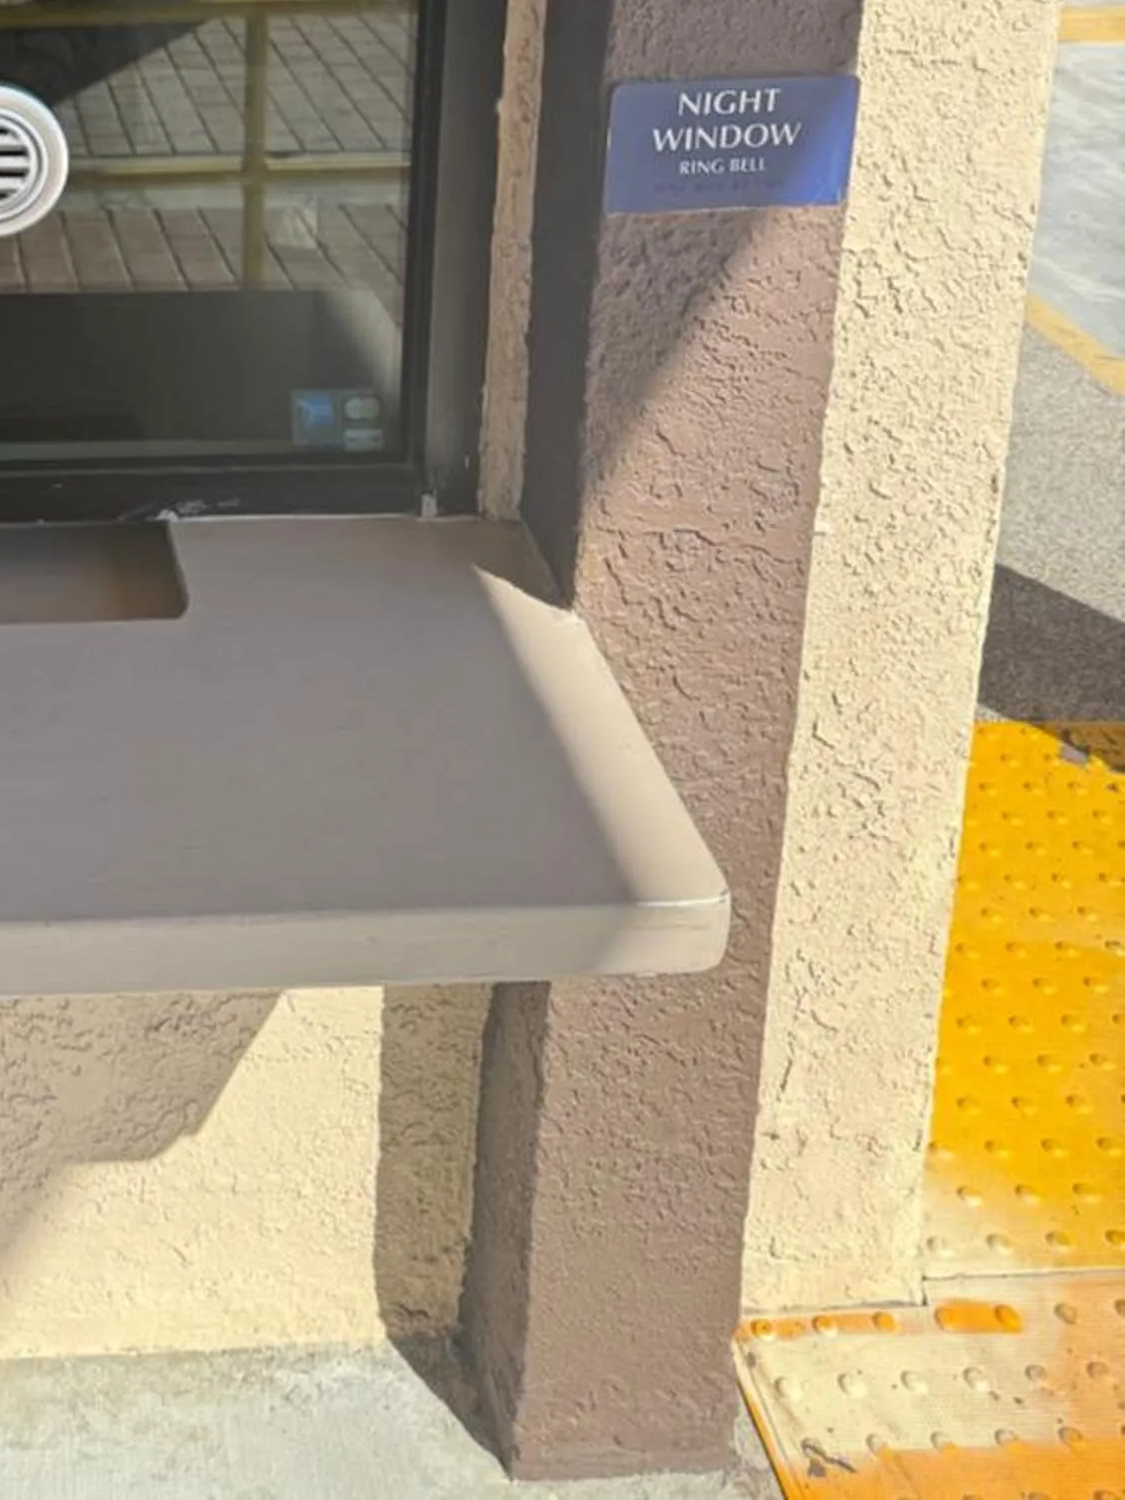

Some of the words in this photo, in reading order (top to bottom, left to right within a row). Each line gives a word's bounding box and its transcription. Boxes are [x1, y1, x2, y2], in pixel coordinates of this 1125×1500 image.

[678, 88, 782, 117] NIGHT
[652, 121, 802, 152] WINDOW
[679, 158, 724, 176] RING
[729, 157, 765, 173] BELL
